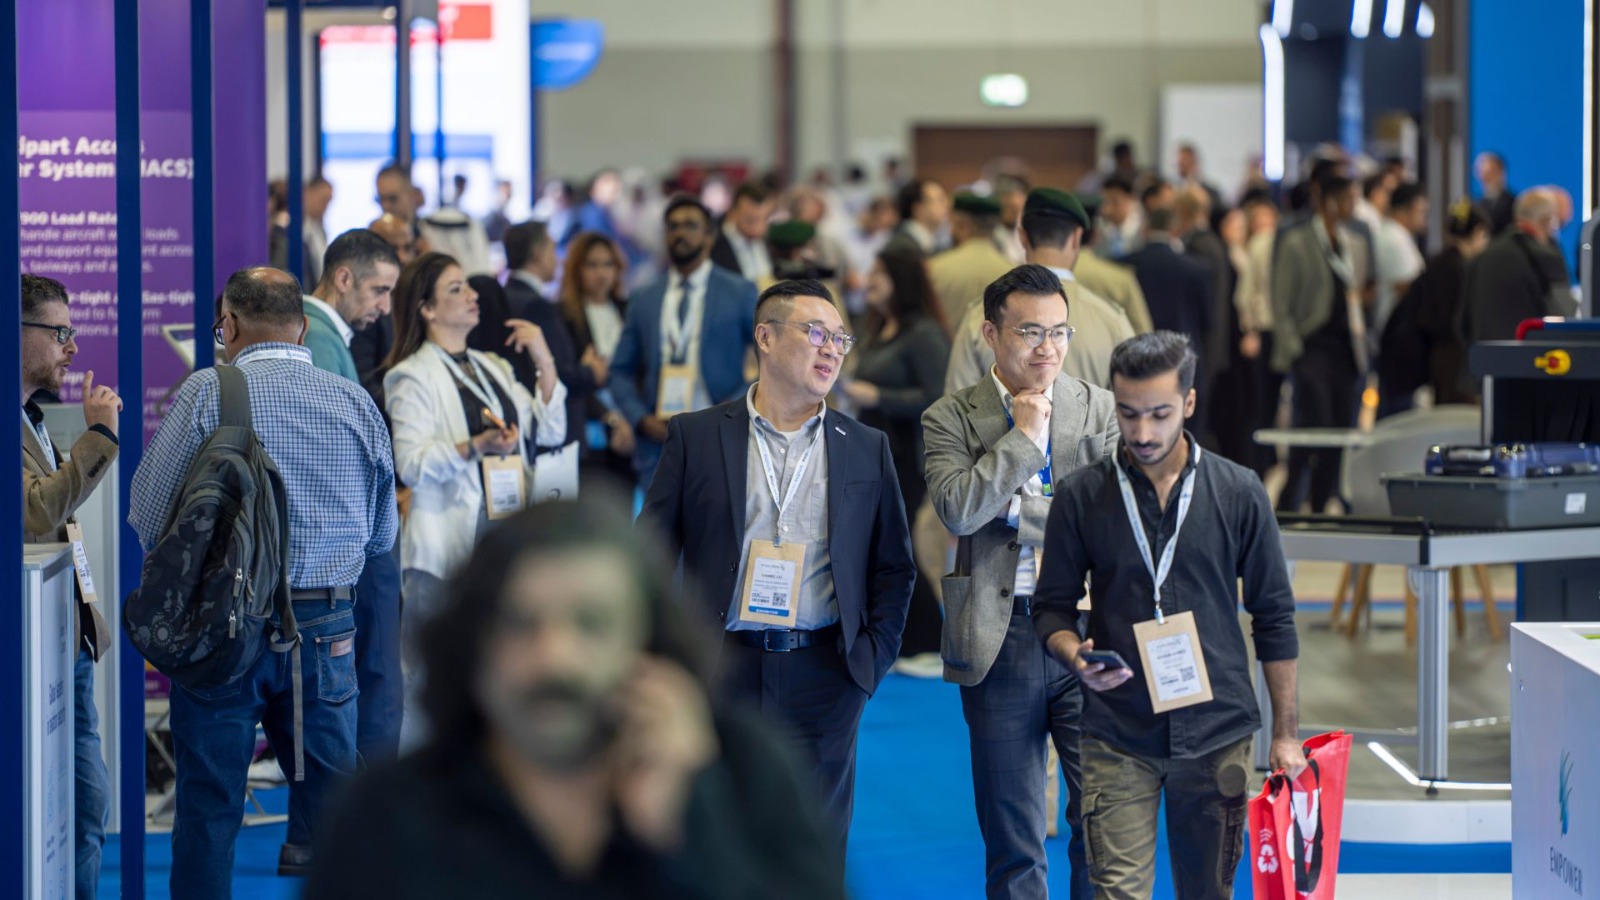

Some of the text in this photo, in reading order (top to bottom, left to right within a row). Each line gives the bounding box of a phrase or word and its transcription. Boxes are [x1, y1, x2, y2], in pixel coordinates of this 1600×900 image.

[38, 159, 116, 181] System
[141, 158, 194, 179] ACS)
[51, 212, 85, 225] Load
[88, 212, 118, 225] Rate
[1550, 846, 1583, 896] EMPOWER
